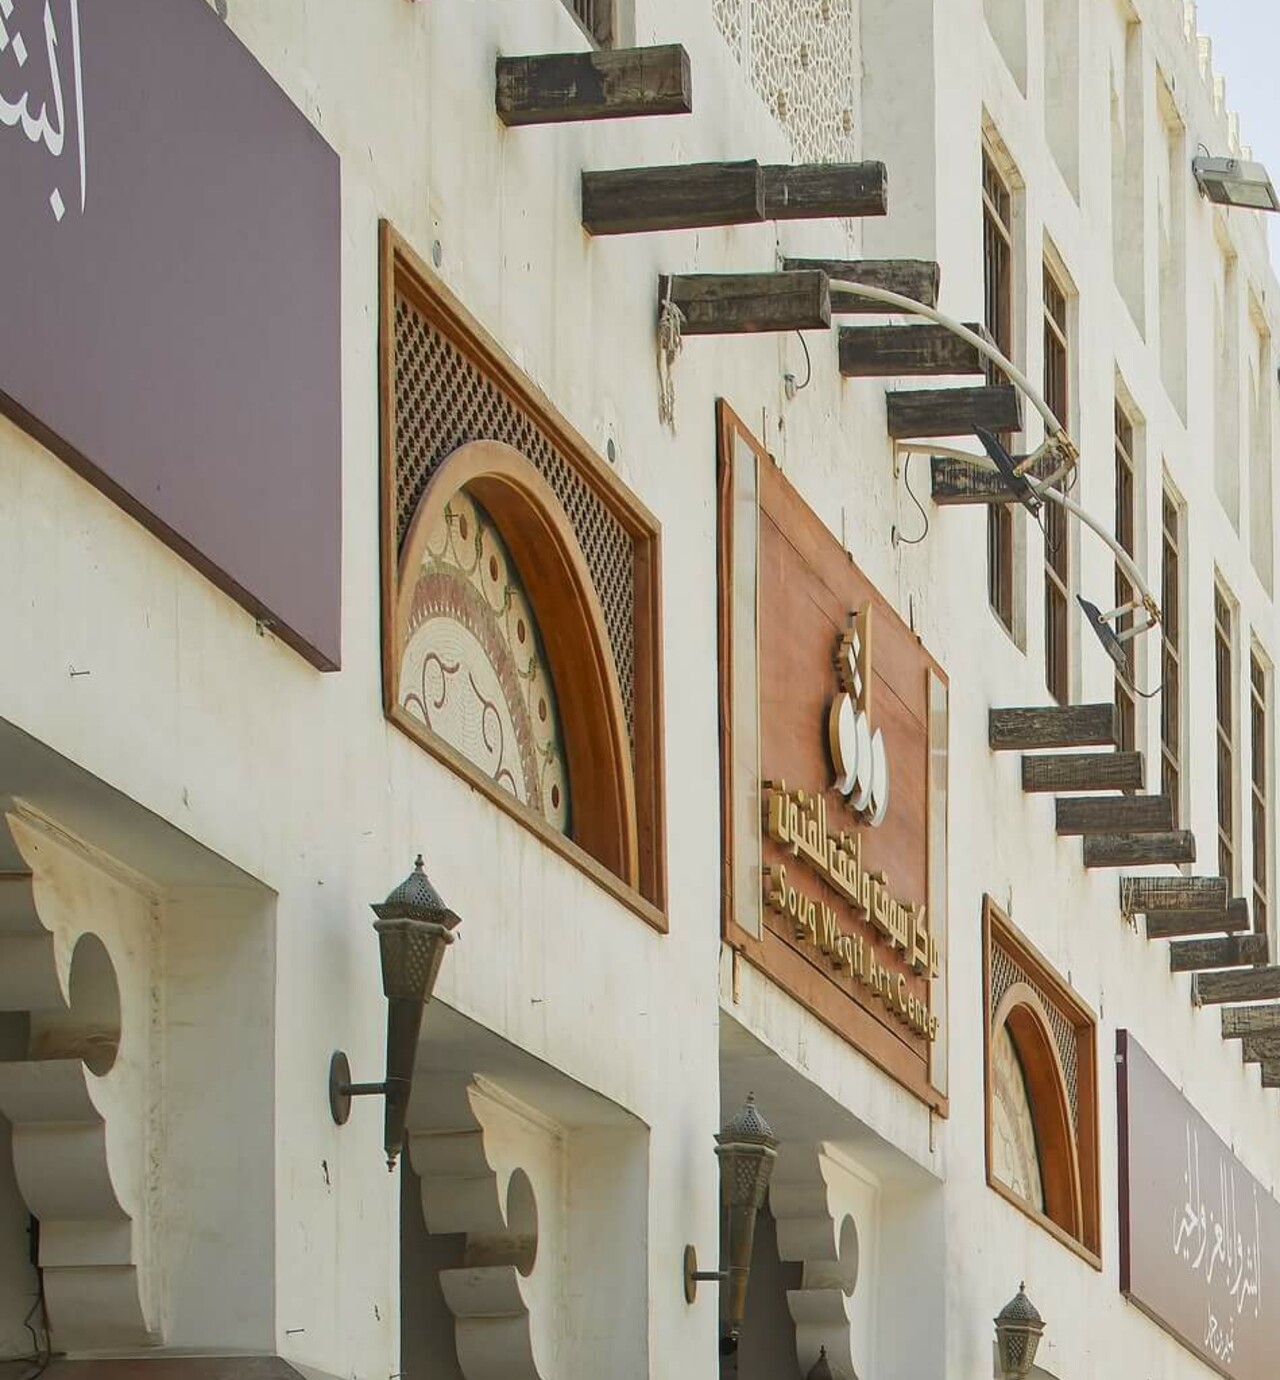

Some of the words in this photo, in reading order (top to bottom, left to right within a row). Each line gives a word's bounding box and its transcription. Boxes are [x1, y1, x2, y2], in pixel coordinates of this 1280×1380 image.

[772, 778, 829, 871] للفنون
[829, 831, 871, 921] واقف
[873, 869, 910, 948] سوق
[777, 864, 817, 945] Souq
[820, 901, 863, 977] Waqif
[868, 946, 892, 999] Art
[897, 973, 940, 1042] Center
